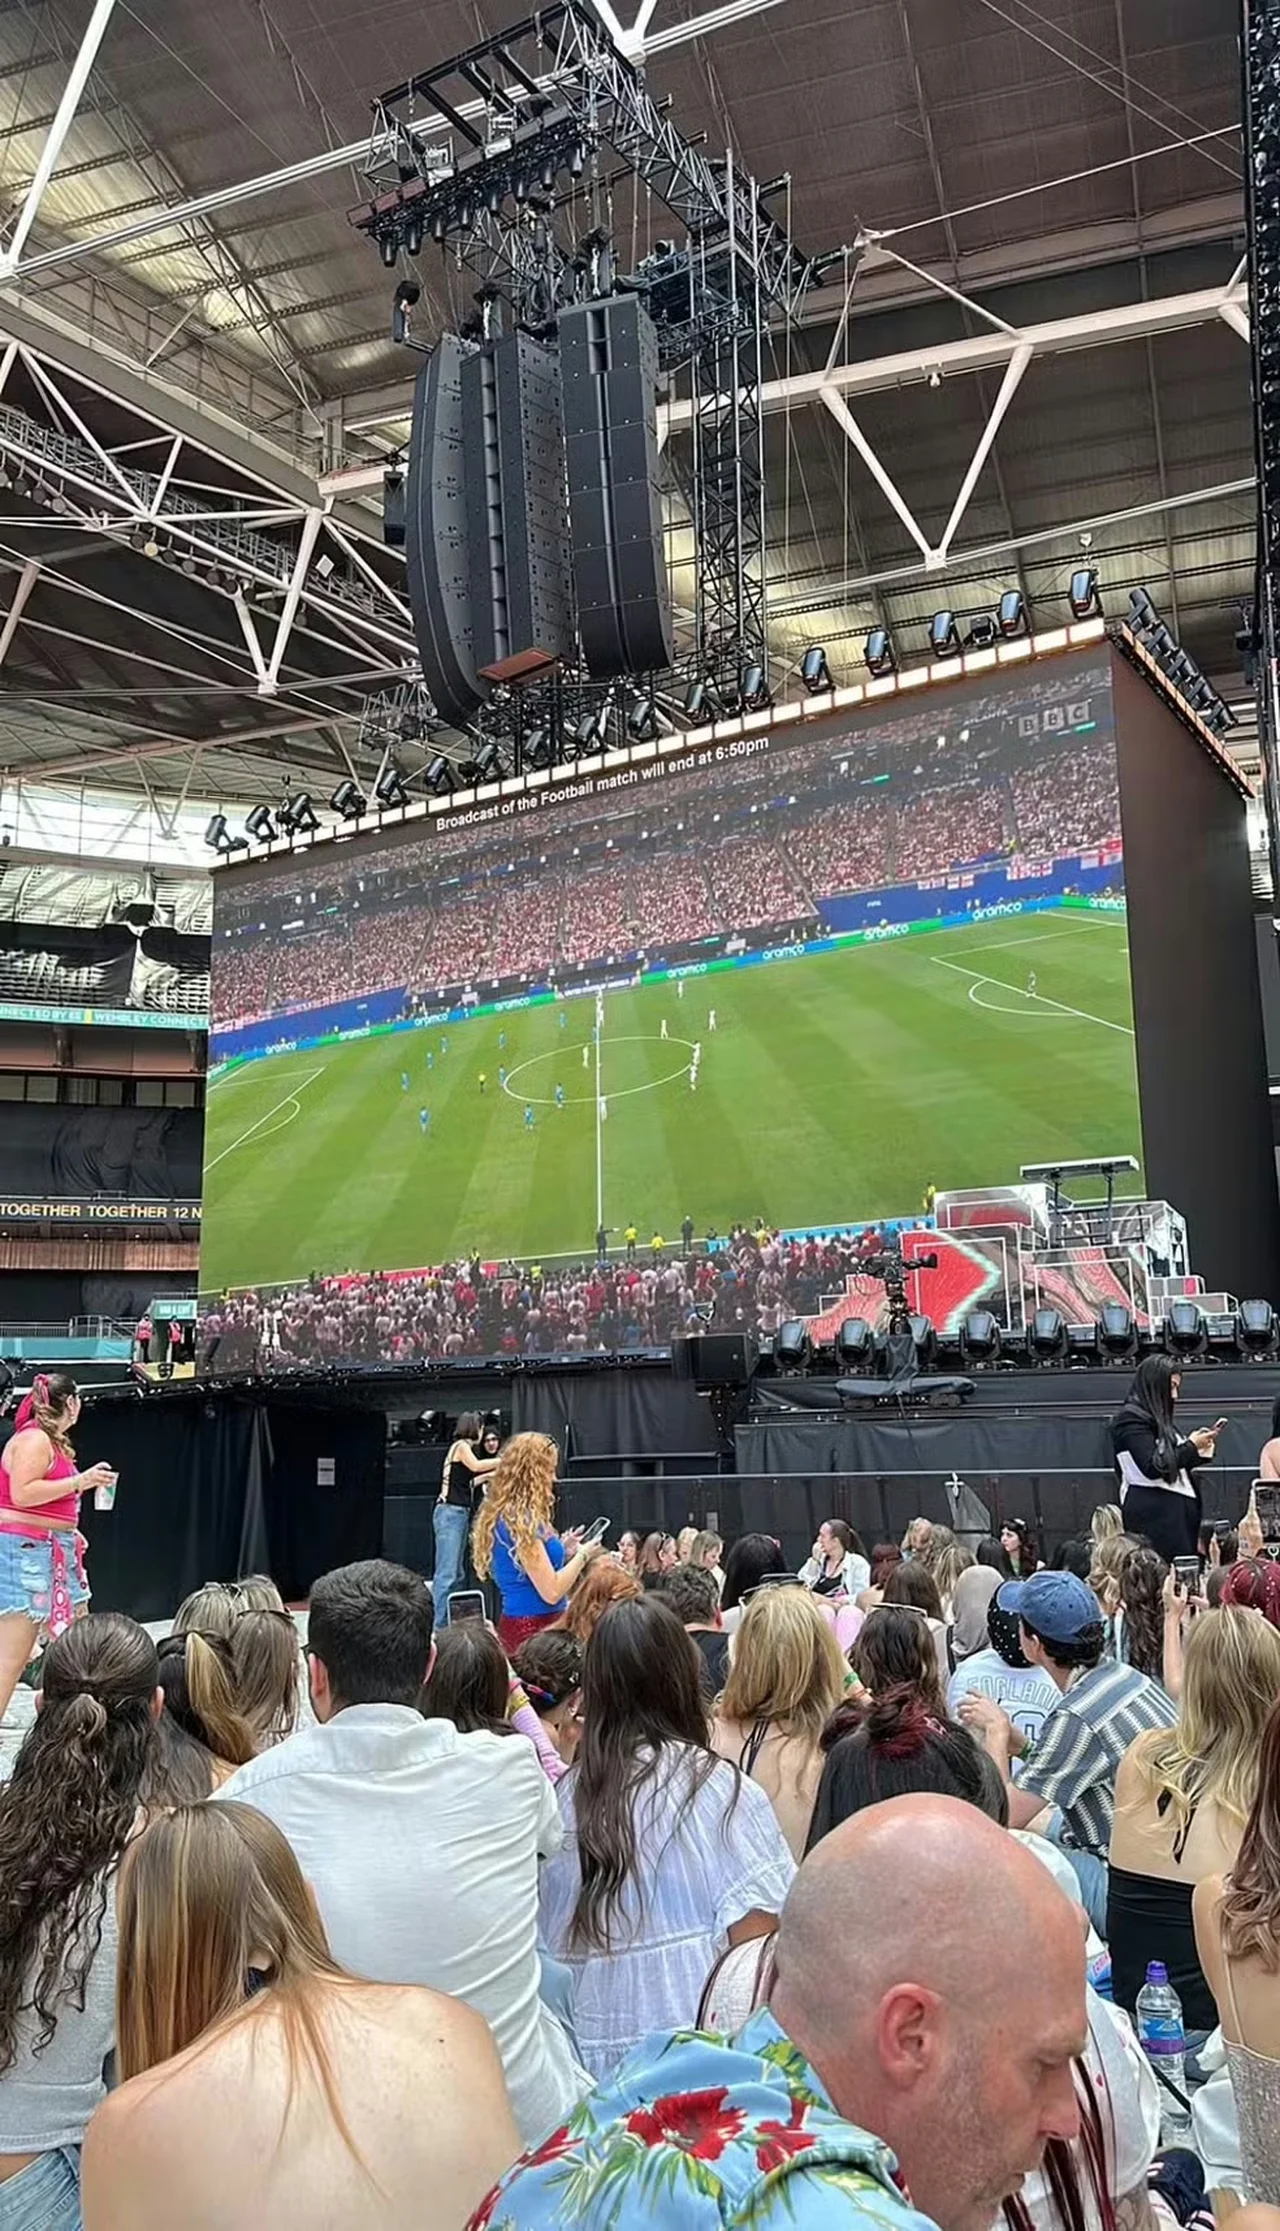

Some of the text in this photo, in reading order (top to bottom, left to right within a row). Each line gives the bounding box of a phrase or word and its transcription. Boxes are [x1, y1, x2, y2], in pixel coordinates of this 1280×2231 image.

[1019, 701, 1089, 737] BBC
[436, 736, 769, 832] Broadcast of the Football match will end at 6:50pm
[972, 901, 1022, 921] aramco
[863, 924, 909, 940] aramco
[762, 944, 805, 960] aramco
[667, 963, 707, 979] aramco
[494, 996, 530, 1012] aramco
[95, 1012, 147, 1024] WEMBLEY
[414, 1012, 448, 1027] aramco
[339, 1027, 371, 1041] aramco
[265, 1041, 297, 1055] aramco
[0, 1203, 81, 1217] TOGETHER
[87, 1205, 168, 1218] TOGETHER
[173, 1207, 189, 1219] 12
